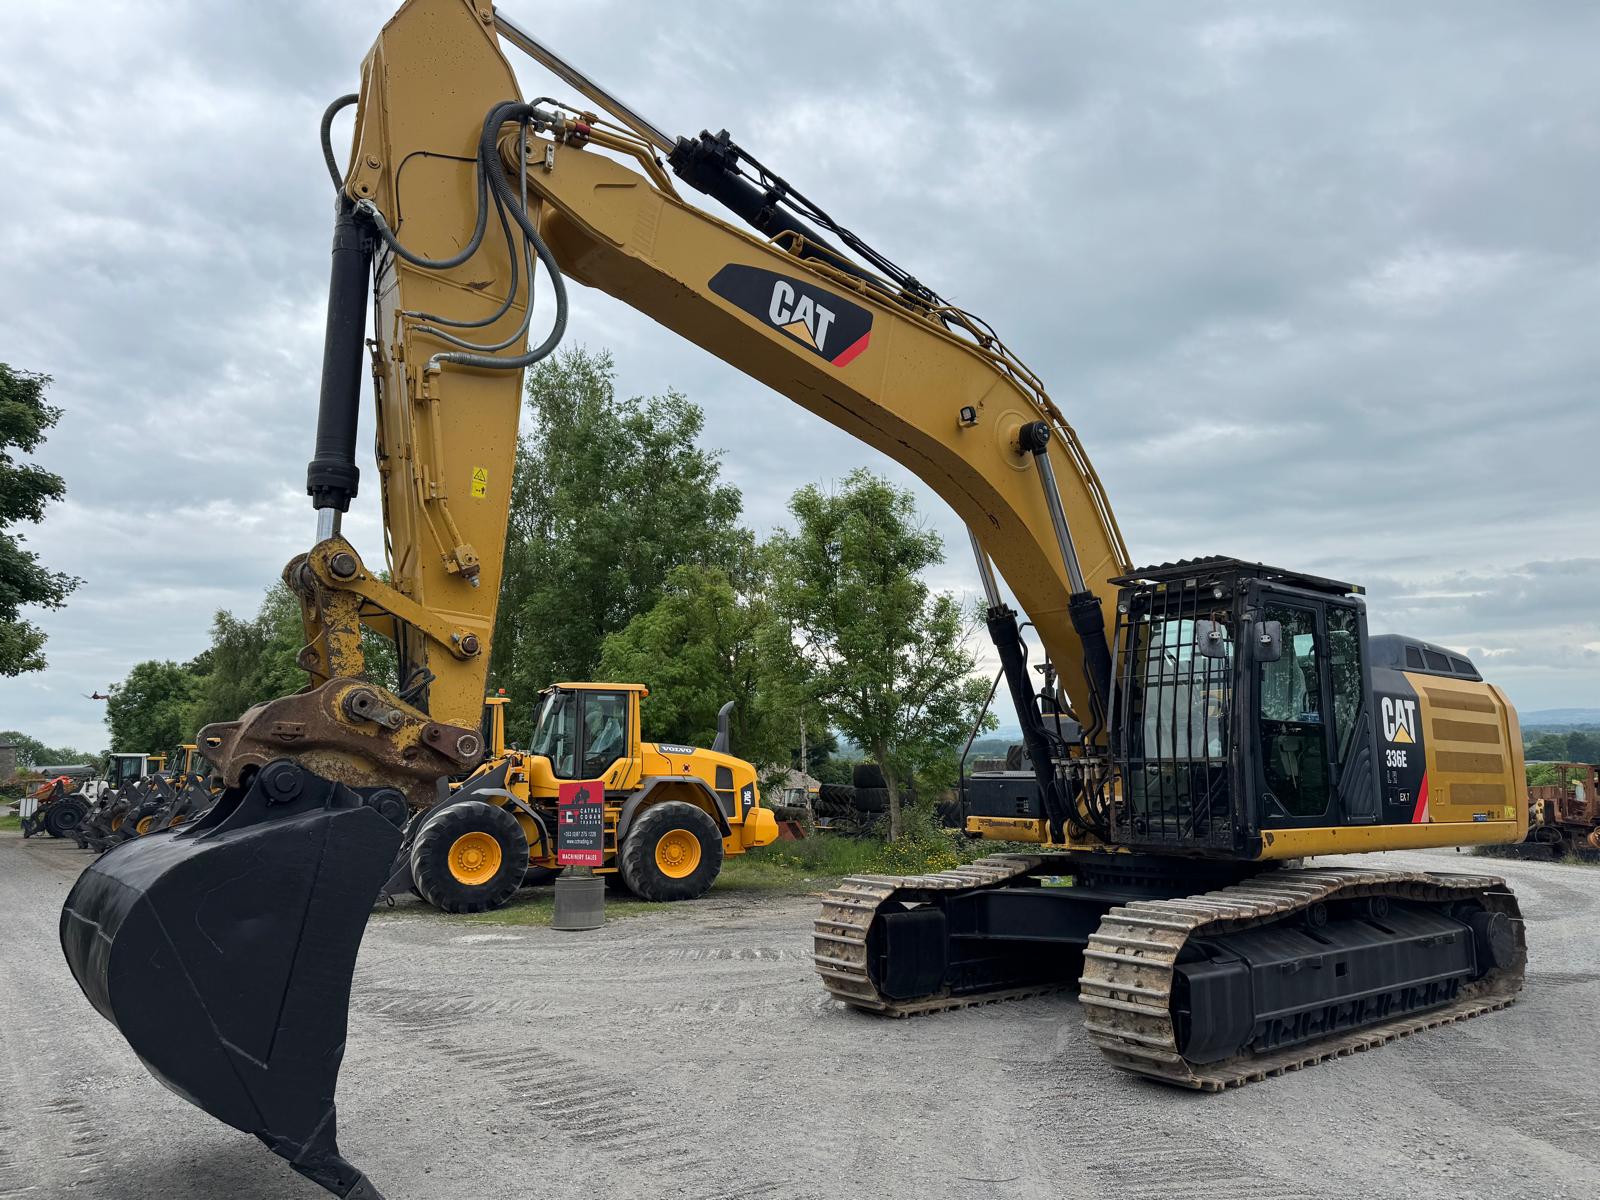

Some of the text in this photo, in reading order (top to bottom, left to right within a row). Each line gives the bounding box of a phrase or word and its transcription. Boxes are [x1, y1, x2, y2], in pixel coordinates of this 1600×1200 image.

[768, 280, 836, 352] CAT
[1381, 697, 1416, 744] CAT
[1385, 749, 1408, 768] 336E
